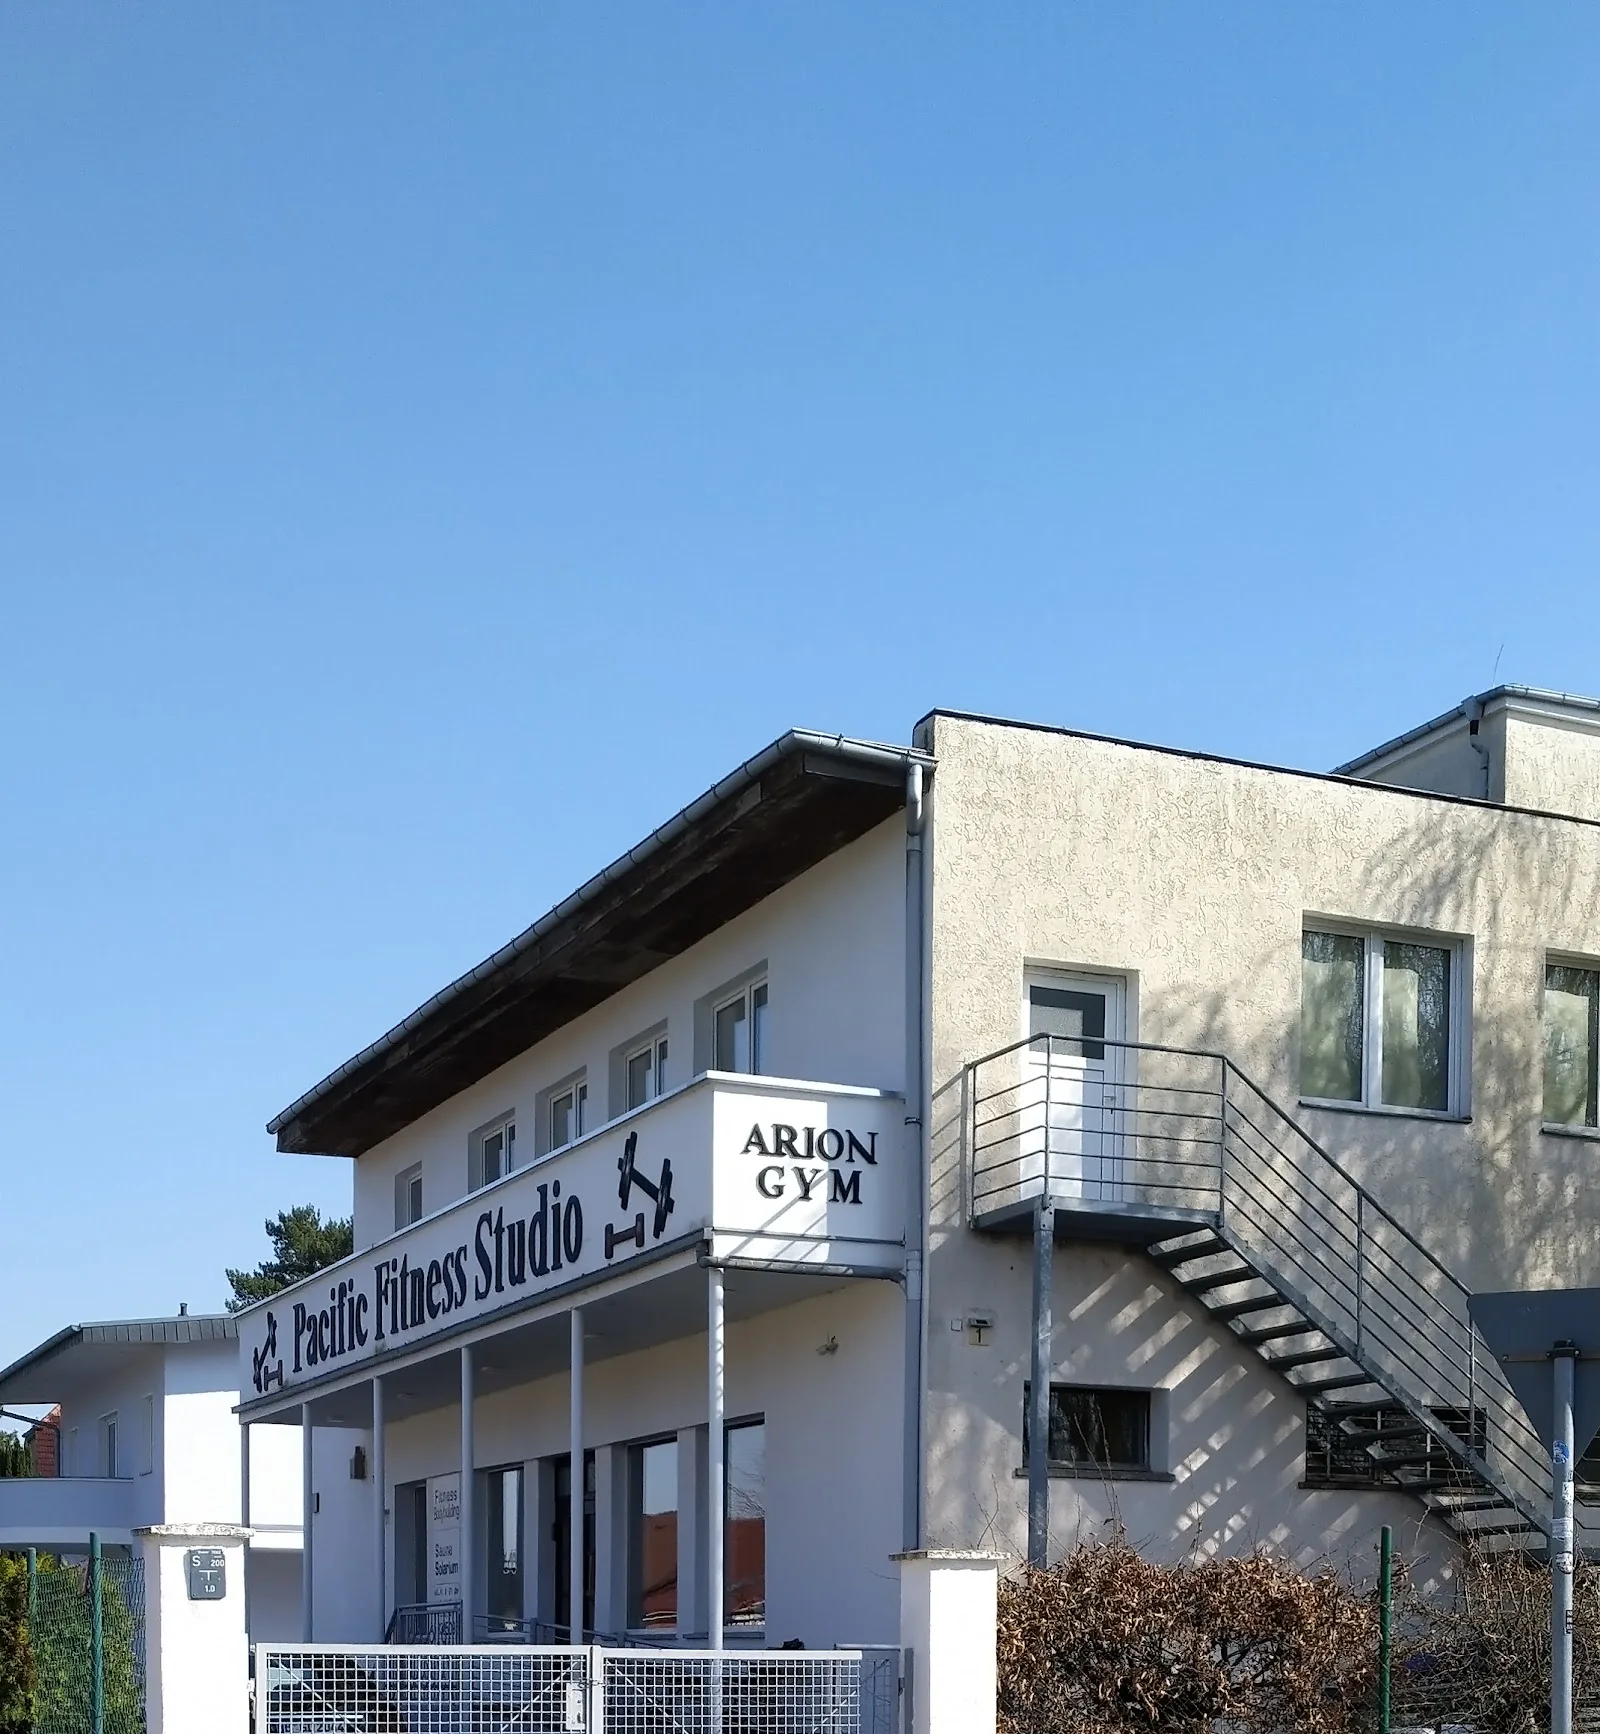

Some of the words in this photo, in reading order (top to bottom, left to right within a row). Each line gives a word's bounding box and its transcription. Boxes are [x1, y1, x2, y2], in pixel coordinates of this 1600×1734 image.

[740, 1123, 878, 1164] ARION
[756, 1166, 862, 1204] GYM
[292, 1278, 369, 1373] Pacific
[374, 1244, 467, 1341] Fitness
[473, 1180, 583, 1300] Studio
[192, 1555, 201, 1567] S
[210, 1559, 225, 1567] 200
[435, 1543, 452, 1558] Sauna
[435, 1561, 458, 1576] Solarium
